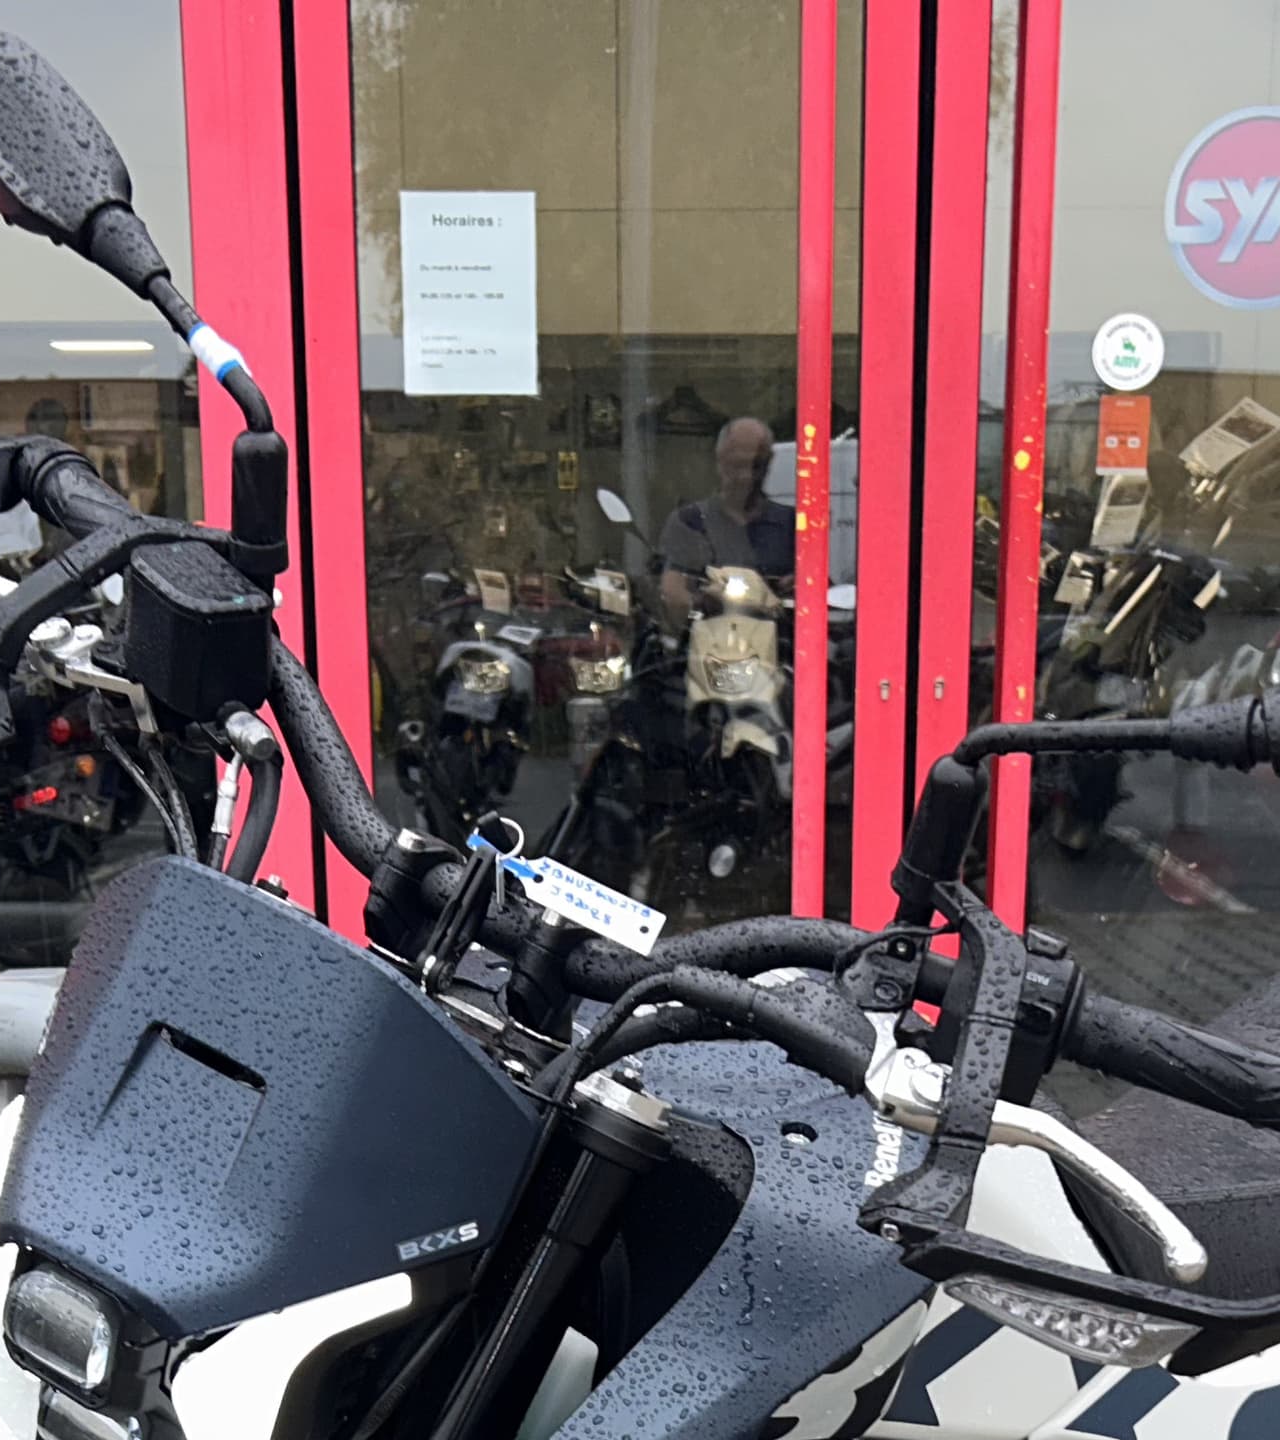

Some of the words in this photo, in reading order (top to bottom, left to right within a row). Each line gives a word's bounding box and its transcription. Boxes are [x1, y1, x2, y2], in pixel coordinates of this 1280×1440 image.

[432, 214, 494, 227] Horaires
[864, 1110, 904, 1188] Benel
[397, 1221, 480, 1261] BKXS
